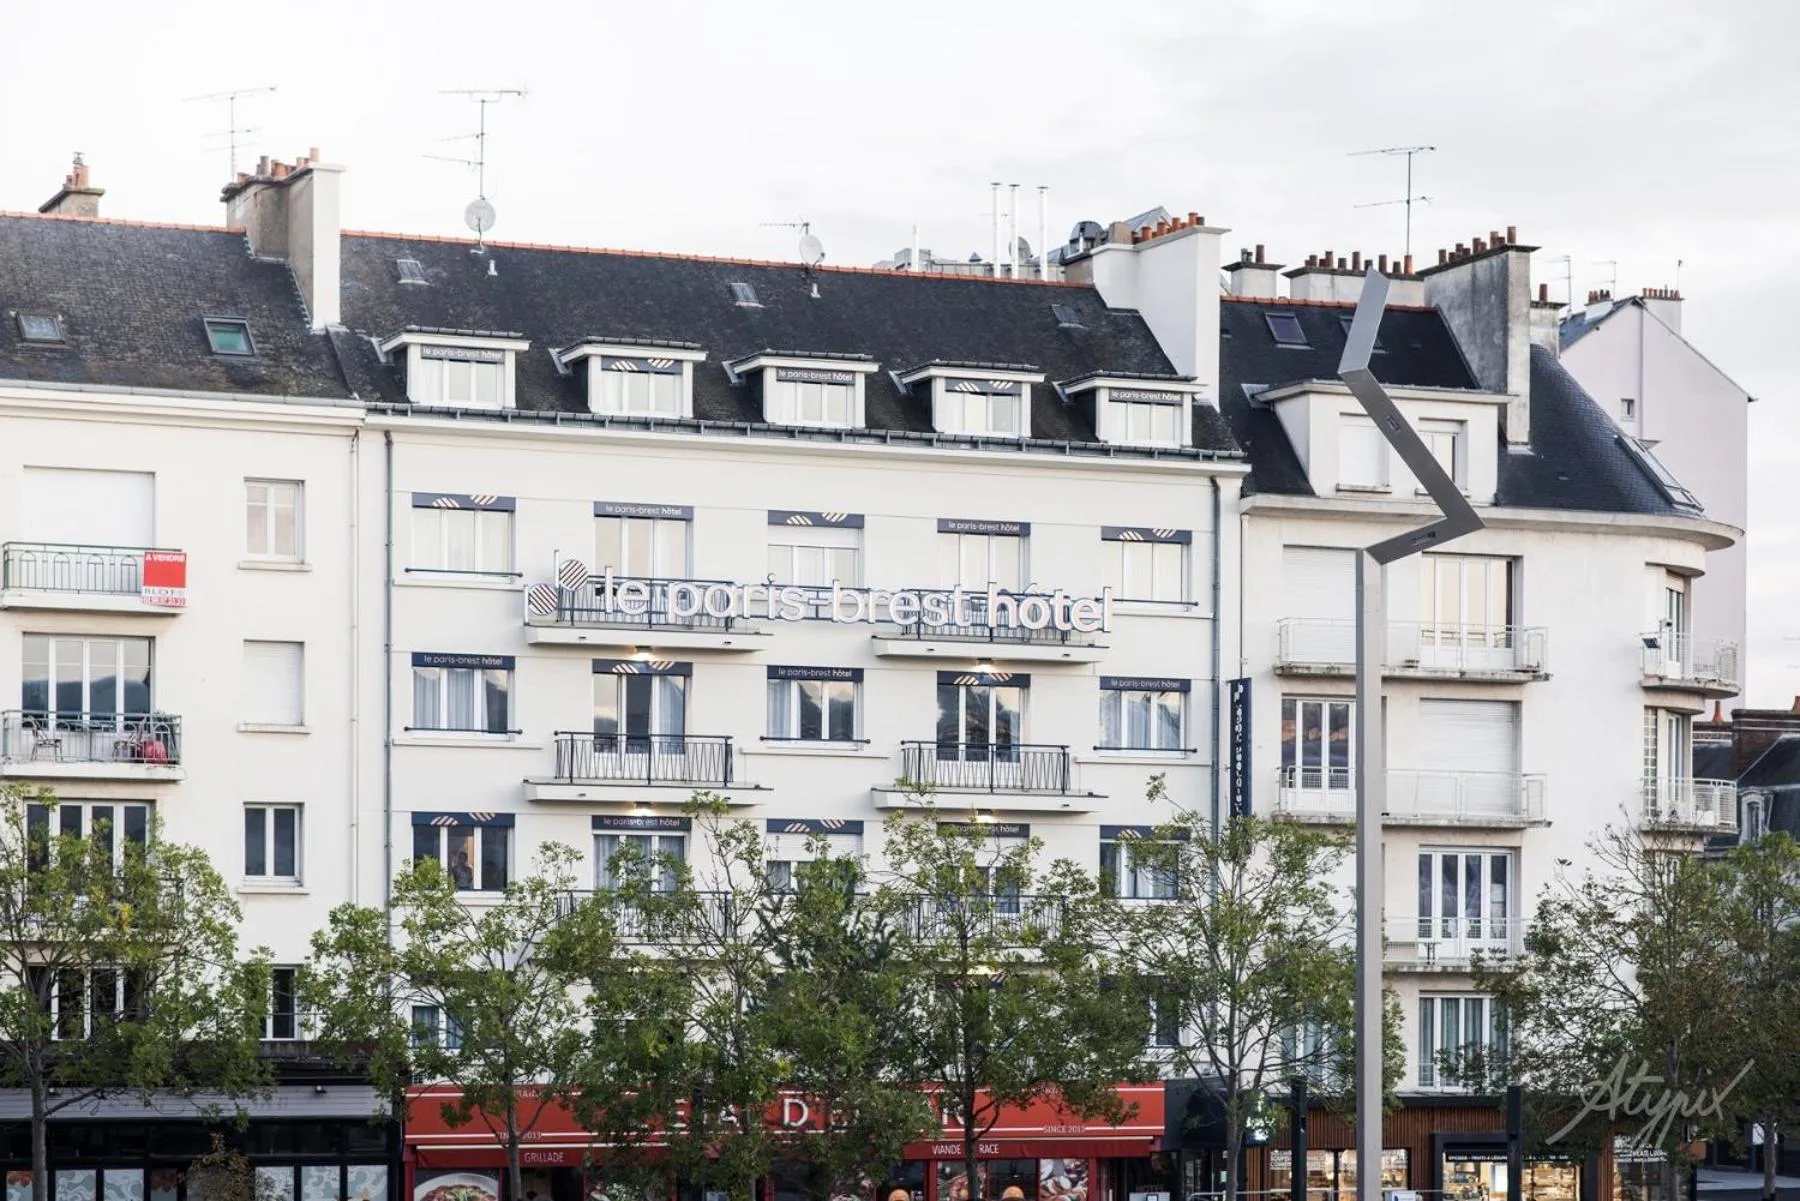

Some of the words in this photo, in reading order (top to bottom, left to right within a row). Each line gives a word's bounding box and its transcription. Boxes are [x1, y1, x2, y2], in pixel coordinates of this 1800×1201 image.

[605, 565, 650, 616] le
[667, 572, 972, 627] paris-brest
[988, 582, 1112, 633] hôtel
[434, 656, 480, 664] paris-brest
[481, 657, 503, 665] hôtel
[787, 668, 831, 677] paris-brest
[832, 669, 853, 677] hôtel
[932, 1143, 961, 1156] VIANDE
[979, 1143, 1000, 1155] RACE
[524, 1152, 564, 1163] GRILLADE
